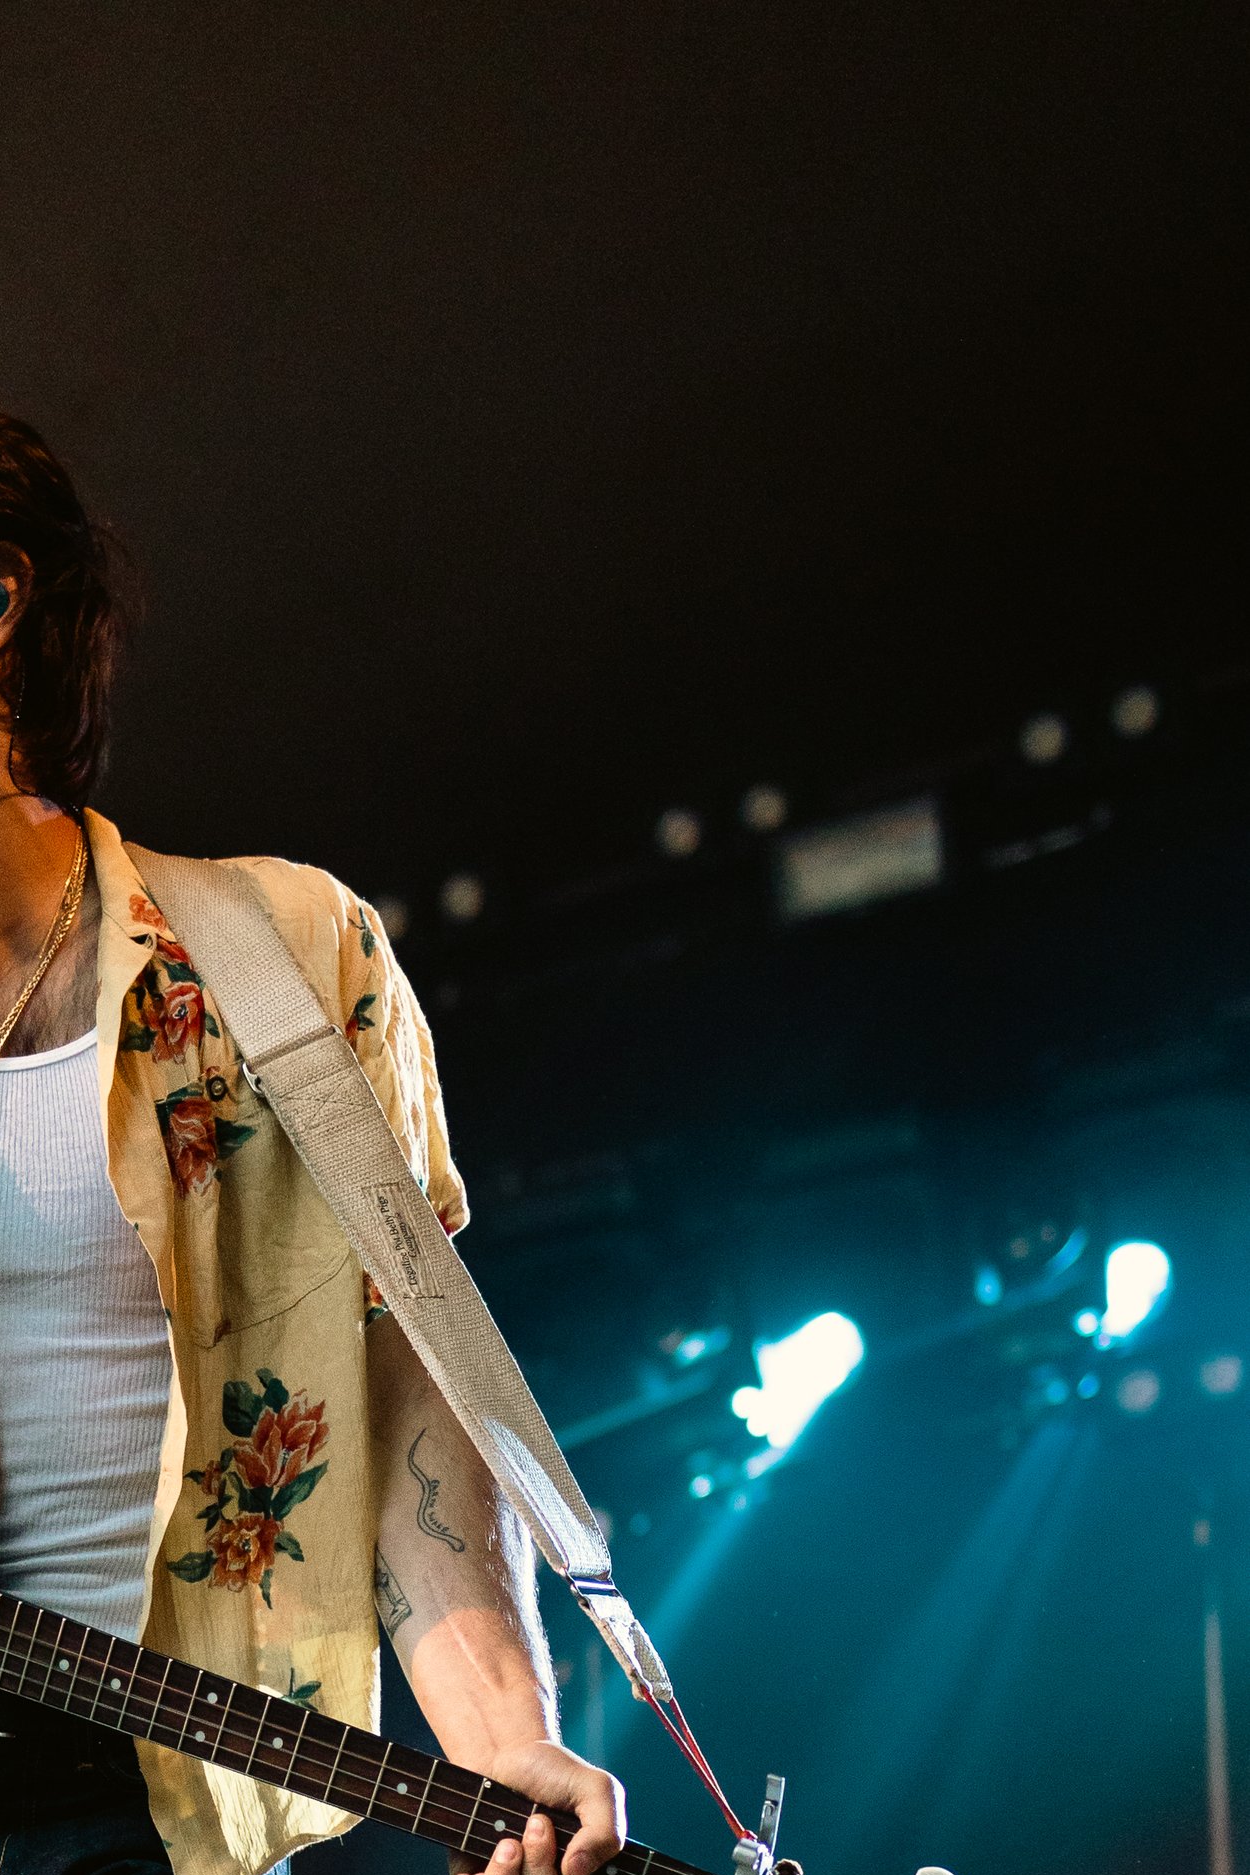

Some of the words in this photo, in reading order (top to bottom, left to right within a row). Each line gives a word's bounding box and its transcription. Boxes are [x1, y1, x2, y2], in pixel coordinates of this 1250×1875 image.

[377, 1195, 390, 1213] Pigs
[385, 1213, 399, 1236] Belly
[392, 1236, 403, 1251] Pot
[399, 1222, 417, 1258] Company
[401, 1252, 418, 1285] Legalize
